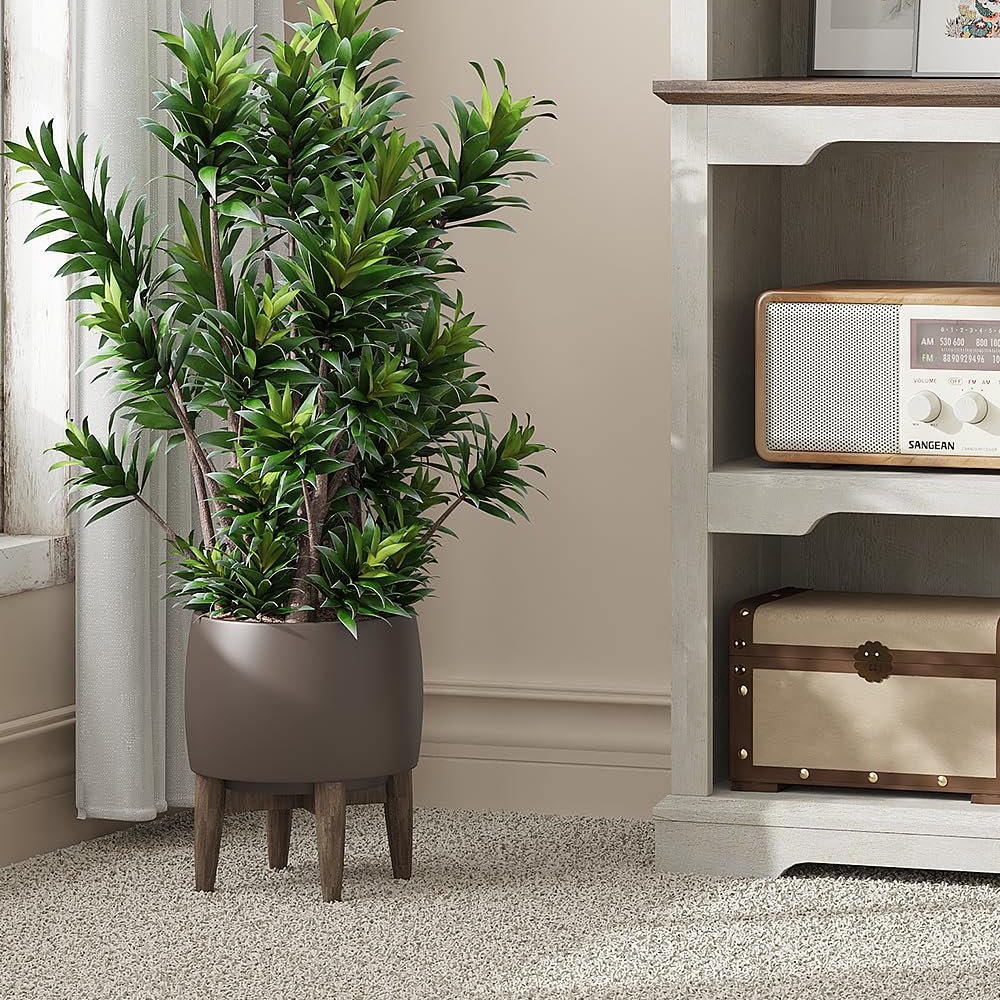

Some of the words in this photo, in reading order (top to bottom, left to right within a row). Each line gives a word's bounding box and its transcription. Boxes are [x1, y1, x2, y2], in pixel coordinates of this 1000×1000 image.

[920, 338, 934, 346] AM
[939, 338, 951, 347] 530
[952, 338, 965, 347] 600
[975, 339, 988, 347] 800
[921, 354, 934, 362] FM
[908, 440, 955, 451] SANGEAN
